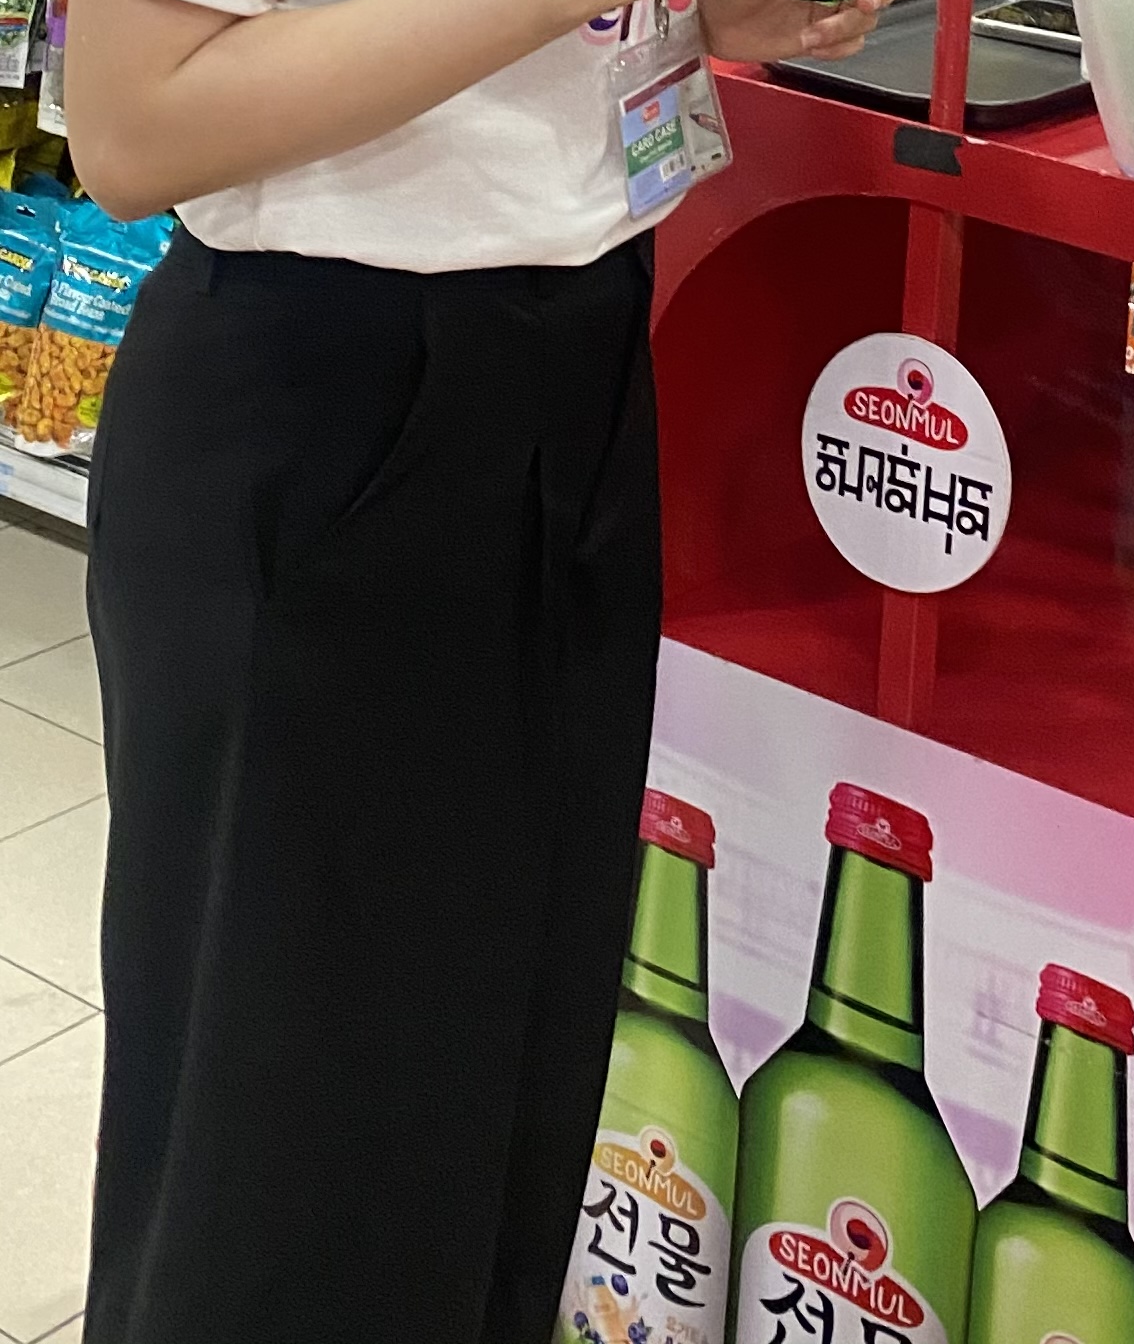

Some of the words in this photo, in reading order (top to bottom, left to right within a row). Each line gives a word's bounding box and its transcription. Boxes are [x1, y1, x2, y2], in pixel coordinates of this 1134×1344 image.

[852, 391, 959, 445] SEONMUL
[600, 1148, 699, 1217] SEONMUL
[778, 1233, 914, 1325] SEONMUL
